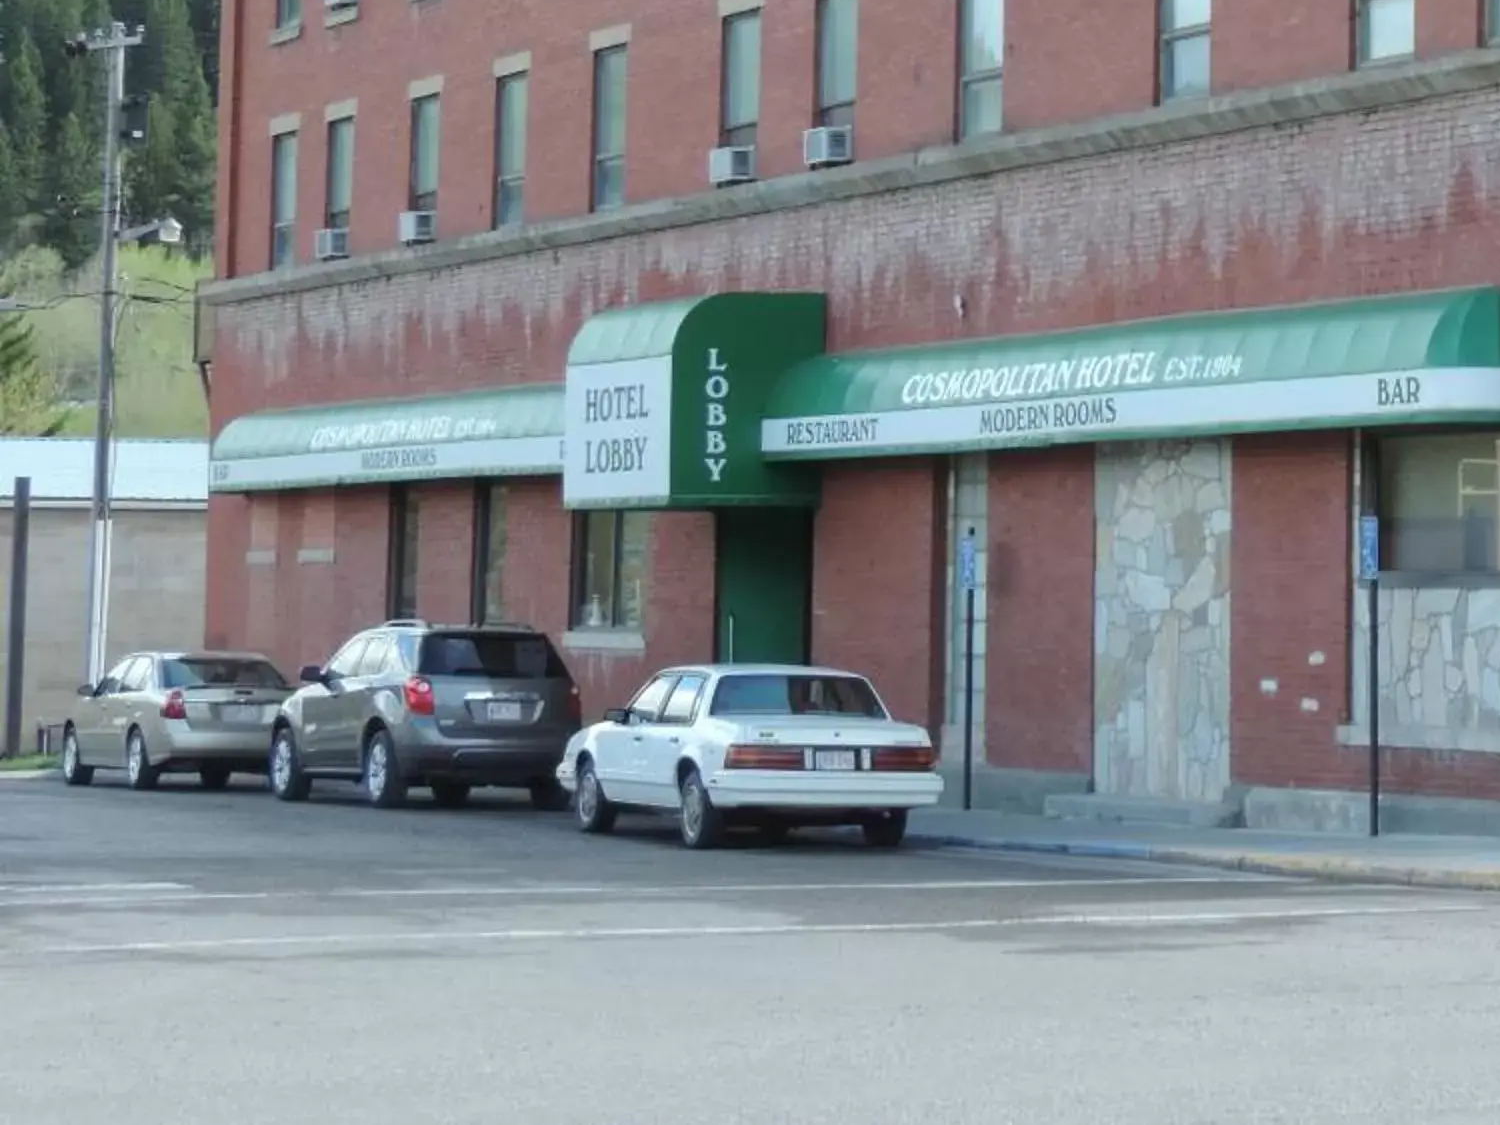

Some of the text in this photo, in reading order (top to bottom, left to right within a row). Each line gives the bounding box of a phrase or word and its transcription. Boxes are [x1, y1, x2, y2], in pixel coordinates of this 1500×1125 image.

[901, 359, 1075, 404] COSMOPOLITAN
[1075, 351, 1157, 391] HOTEL
[1376, 376, 1421, 407] BAR
[585, 383, 649, 423] HOTEL
[703, 347, 730, 482] LOBBY
[979, 397, 1117, 434] MODERN ROOMS
[786, 417, 880, 445] RESTAURANT
[585, 436, 649, 474] LOBBY
